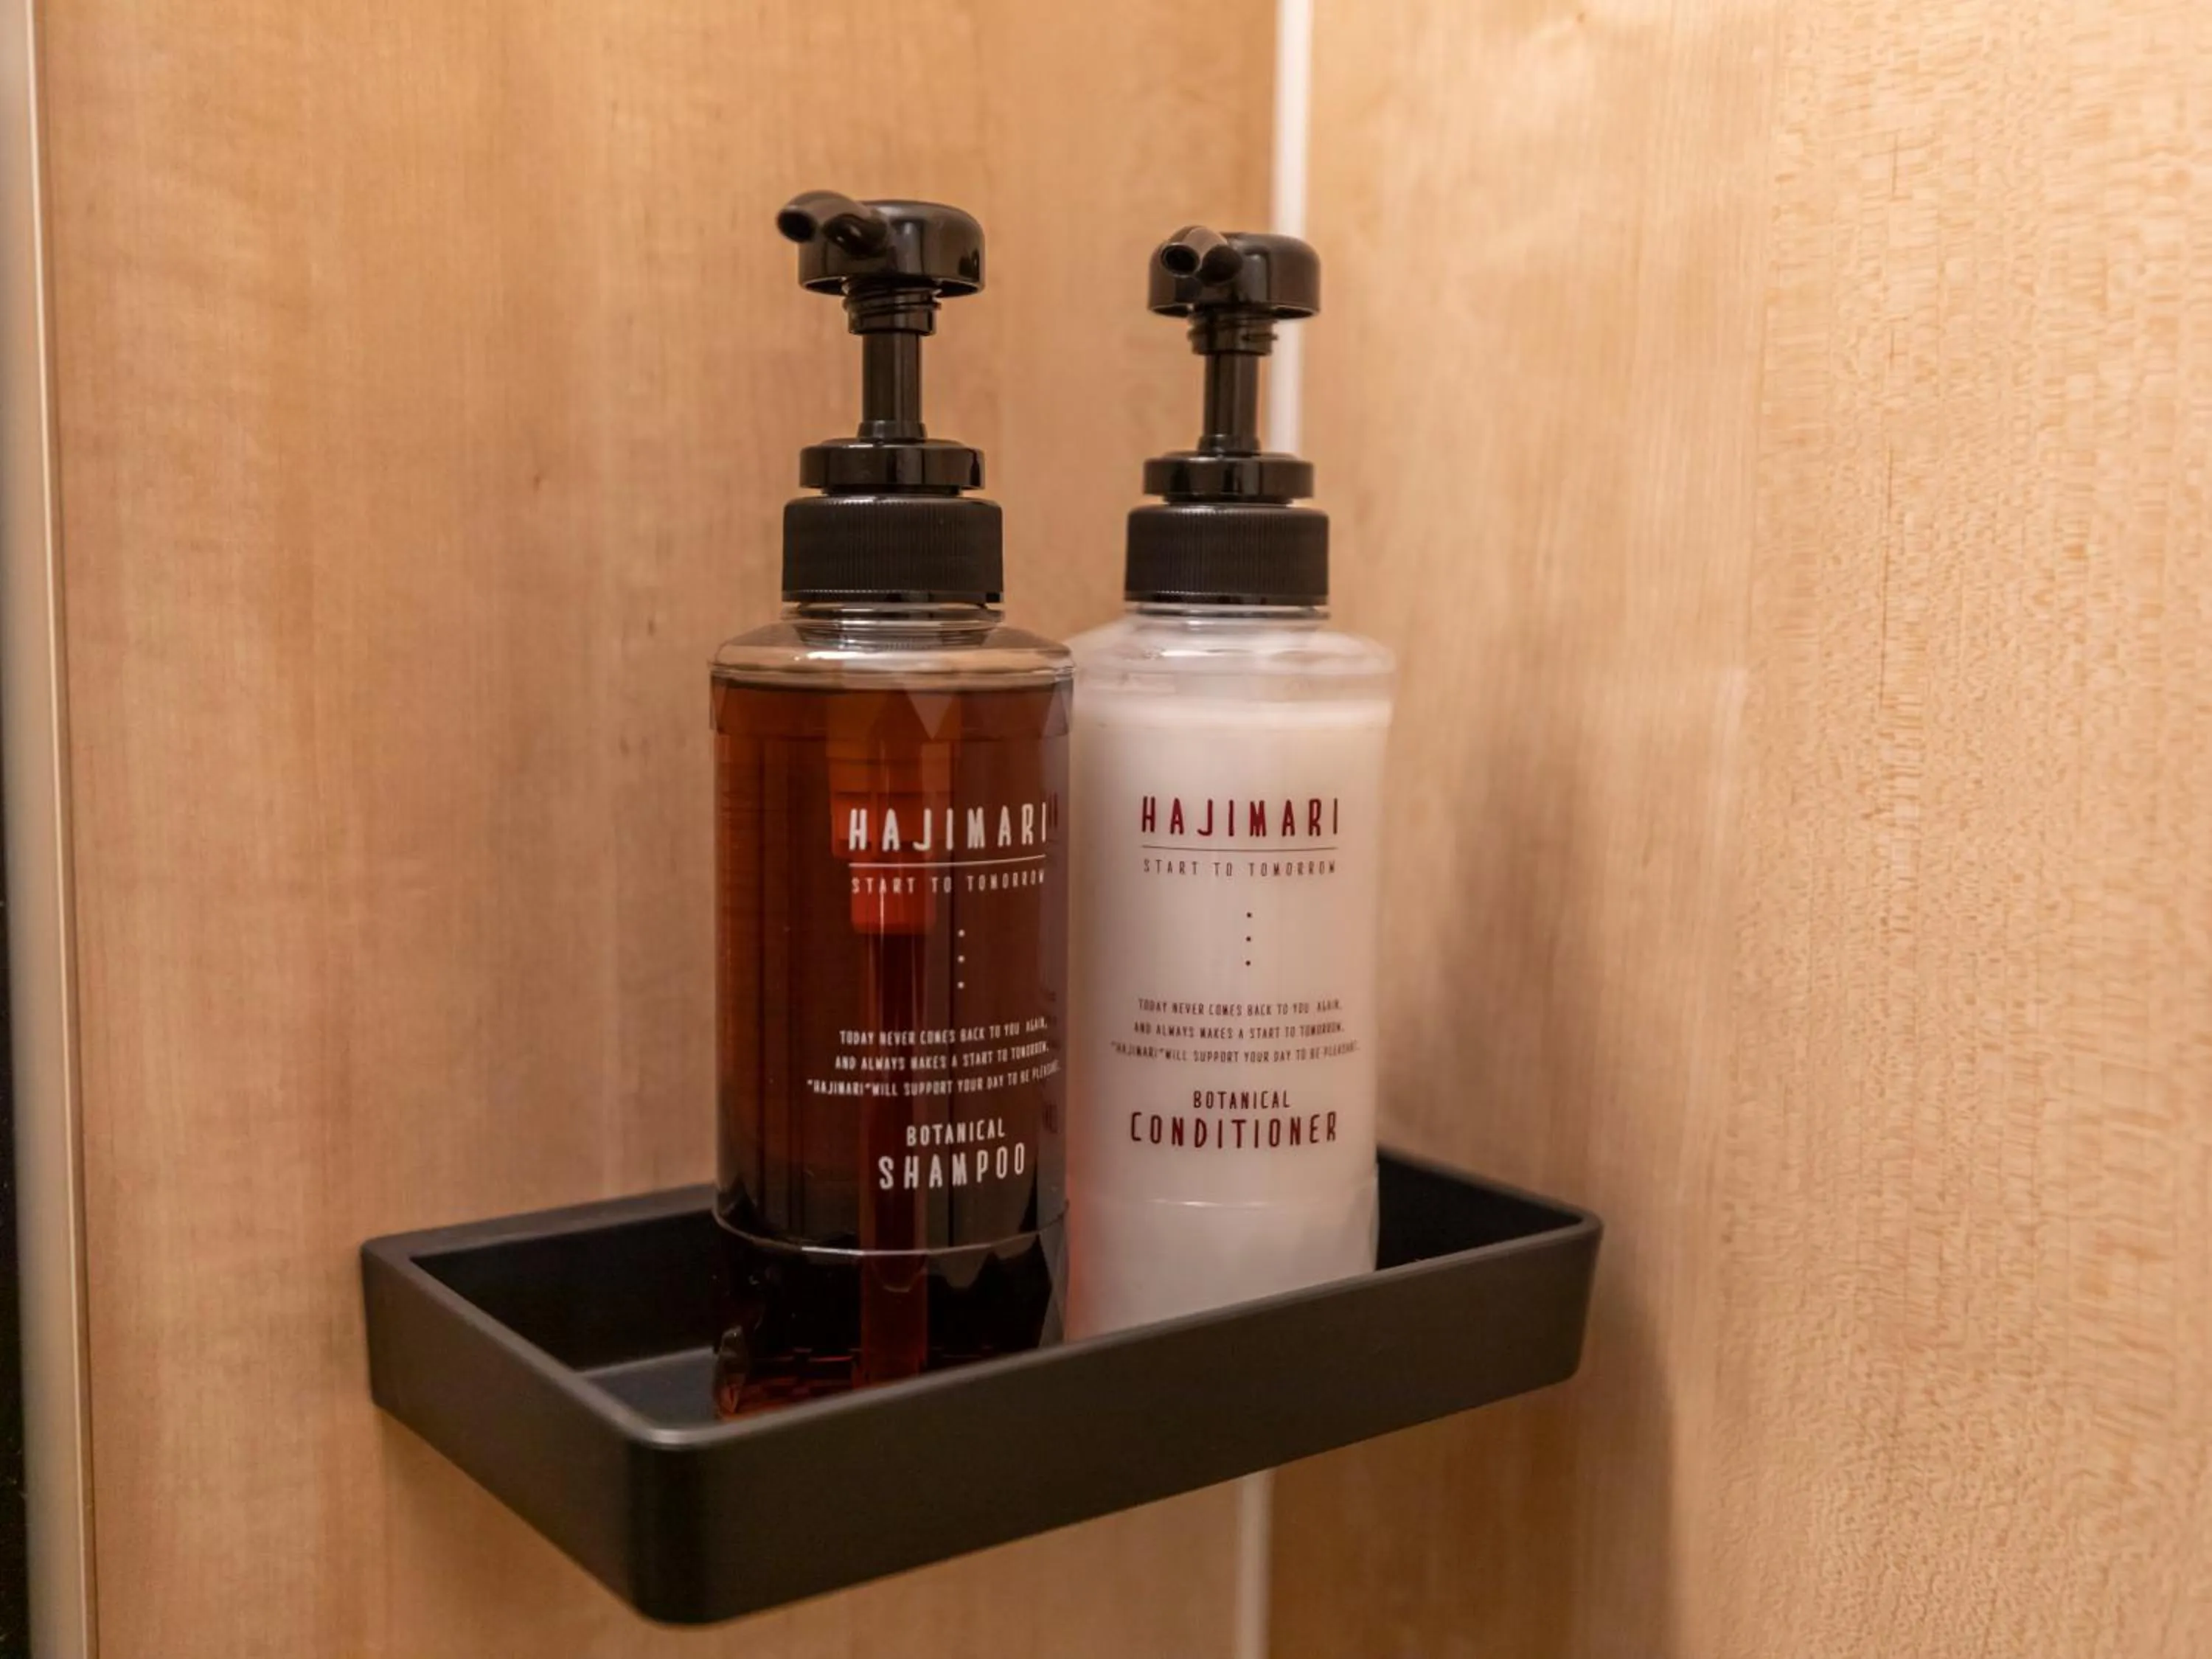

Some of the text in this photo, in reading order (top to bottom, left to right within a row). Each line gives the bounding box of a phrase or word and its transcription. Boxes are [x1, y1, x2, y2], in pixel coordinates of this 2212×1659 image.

[849, 801, 1046, 851] HAJIMARI
[1141, 796, 1338, 837] HAJIMARI
[1144, 859, 1335, 877] START TO TOMORROW
[852, 869, 1045, 894] START TO TOMORROW
[1138, 998, 1167, 1013] TODAY
[1172, 1002, 1204, 1015] NEVER
[1209, 1004, 1242, 1016] COMES
[1248, 1004, 1272, 1016] BACK
[1277, 1003, 1288, 1015] TO
[1293, 1002, 1310, 1014] YOU
[839, 1030, 874, 1046] TODAY
[880, 1030, 916, 1046] NEVER
[920, 1029, 956, 1045] COMES
[961, 1025, 985, 1043] BACK
[990, 1023, 1001, 1039] TO
[1134, 1021, 1151, 1035] AND
[1156, 1024, 1194, 1037] ALWAYS
[1200, 1026, 1233, 1039] MAKES
[1239, 1027, 1244, 1039] A
[1250, 1026, 1280, 1039] START
[1285, 1026, 1295, 1037] TO
[835, 1055, 856, 1070] AND
[860, 1056, 905, 1071] ALWAYS
[911, 1054, 947, 1070] MAKES
[951, 1054, 958, 1067] A
[962, 1049, 992, 1067] START
[997, 1048, 1008, 1062] TO
[1194, 1050, 1239, 1062] SUPPORT
[1245, 1051, 1269, 1063] YOUR
[1274, 1050, 1291, 1062] DAY
[1296, 1048, 1306, 1061] TO
[903, 1080, 953, 1096] SUPPORT
[958, 1077, 983, 1093] YOUR
[987, 1074, 1004, 1090] DAY
[1008, 1072, 1018, 1086] TO
[1193, 1090, 1291, 1110] BOTANICAL
[906, 1117, 1006, 1147] BOTANICAL
[1130, 1110, 1336, 1149] CONDITIONER
[878, 1142, 1026, 1190] SHAMPOO
